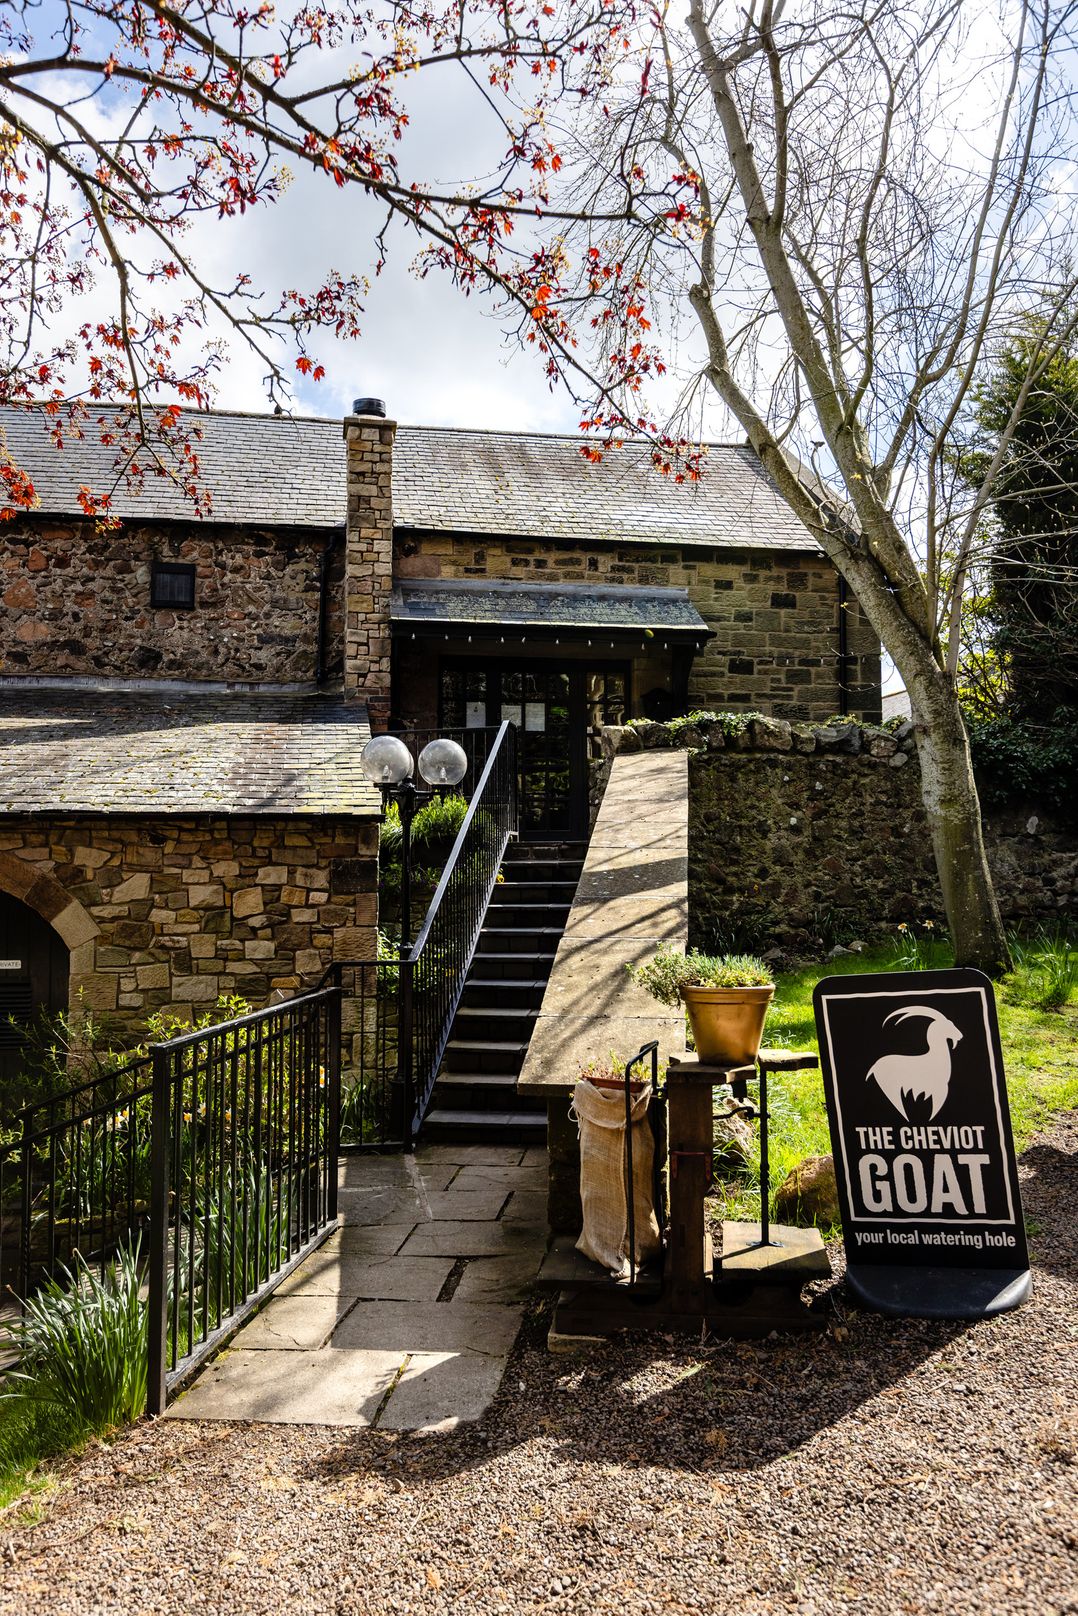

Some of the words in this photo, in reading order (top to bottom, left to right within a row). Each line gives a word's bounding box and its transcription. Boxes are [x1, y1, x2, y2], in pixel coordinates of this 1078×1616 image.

[855, 1126, 895, 1150] THE
[900, 1125, 985, 1150] CHEVIOT
[858, 1153, 991, 1215] GOAT
[855, 1231, 884, 1246] your
[887, 1229, 919, 1245] local
[921, 1230, 983, 1249] watering
[985, 1231, 1016, 1247] hole
